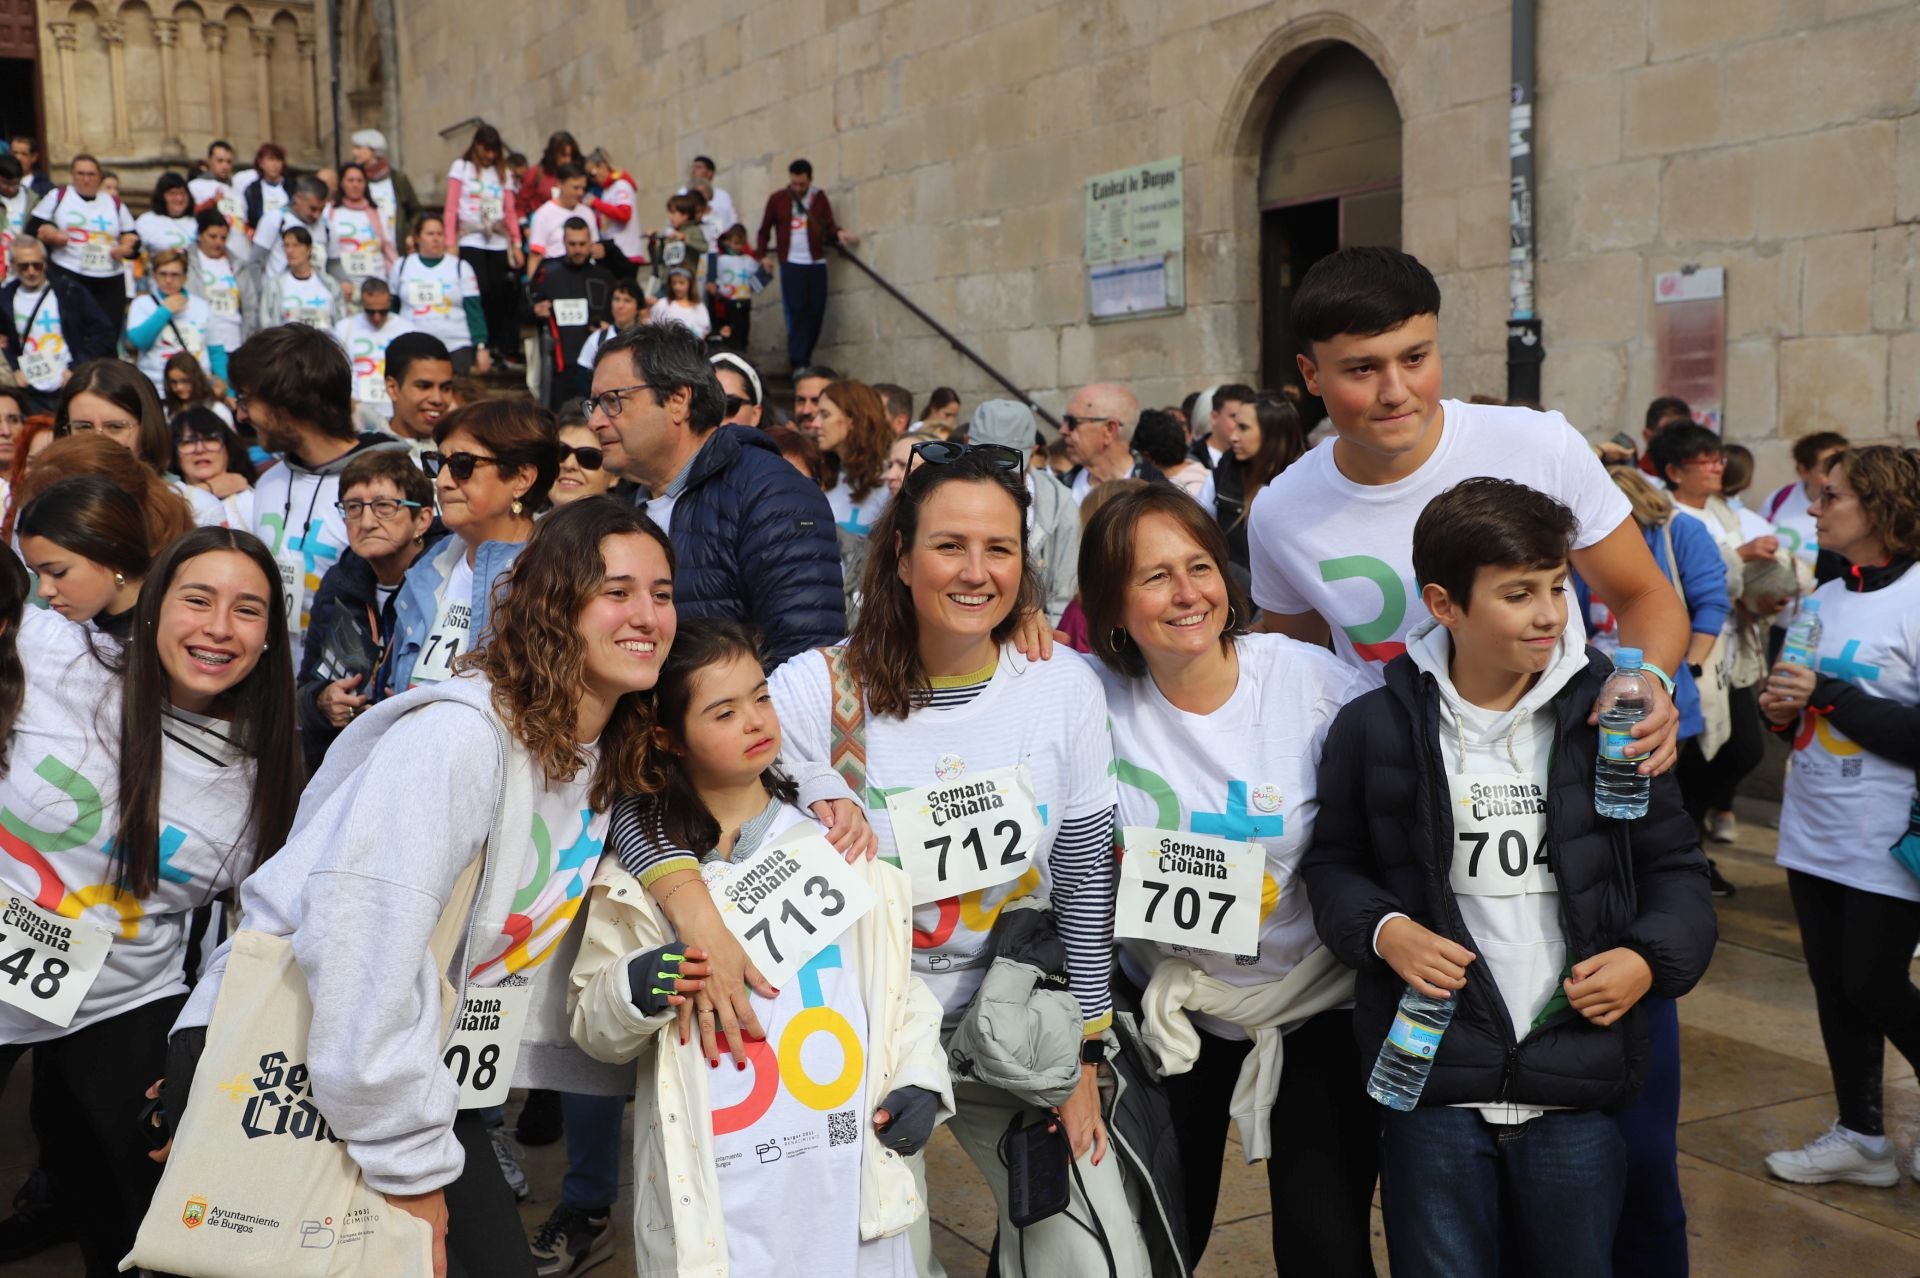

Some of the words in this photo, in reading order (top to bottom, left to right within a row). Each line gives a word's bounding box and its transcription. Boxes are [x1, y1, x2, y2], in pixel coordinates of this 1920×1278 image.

[927, 779, 997, 808] Semana
[931, 794, 1004, 827] Cidiana
[1470, 782, 1543, 800] Semana
[1472, 798, 1548, 822] Cidiana
[923, 819, 1027, 882] 712
[1158, 854, 1228, 880] Cidiana
[1159, 837, 1226, 863] Semana
[1459, 829, 1555, 878] 704
[724, 849, 787, 903] Semana
[736, 858, 802, 915] Cidiana
[8, 897, 73, 939] Semana
[743, 875, 846, 964] 713
[1142, 879, 1236, 935] 707
[2, 909, 71, 953] Cidiana
[253, 1051, 314, 1098] Se
[207, 1216, 219, 1226] de
[221, 1218, 254, 1234] Burgos
[210, 1206, 280, 1228] Ayuntamiento
